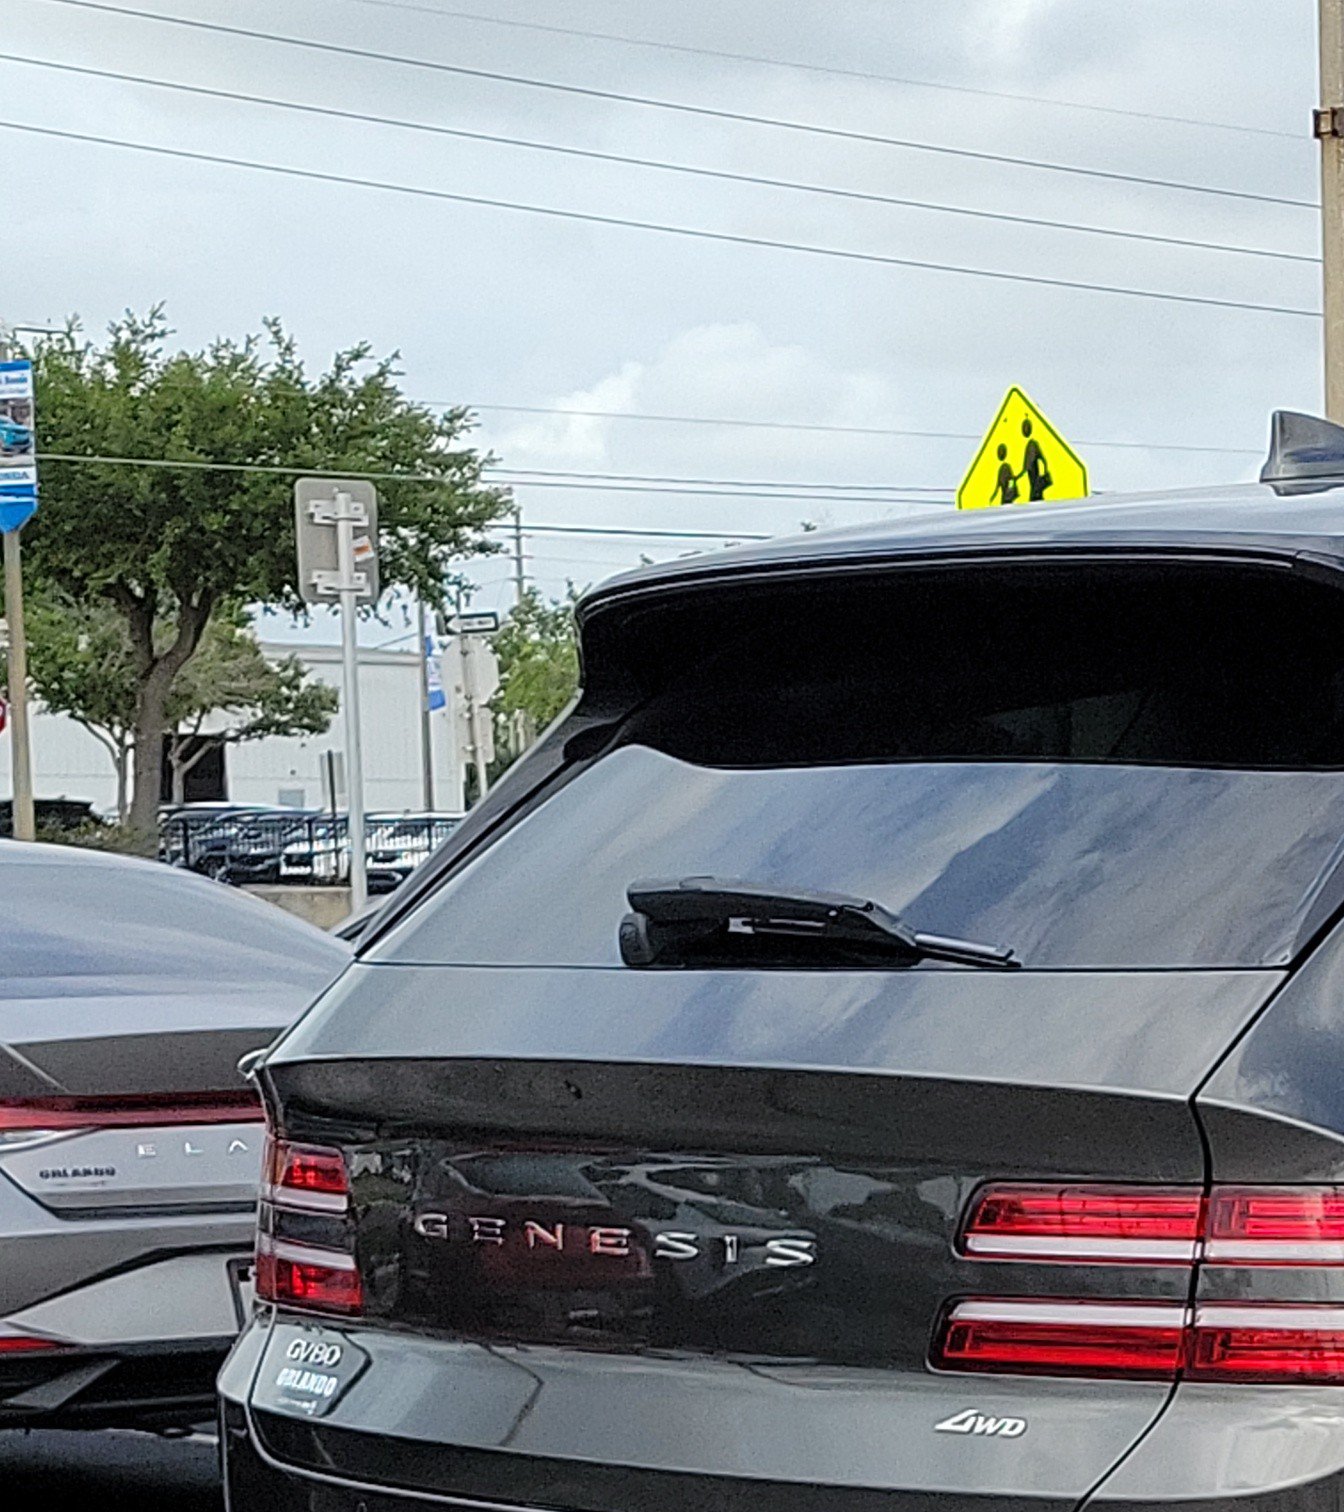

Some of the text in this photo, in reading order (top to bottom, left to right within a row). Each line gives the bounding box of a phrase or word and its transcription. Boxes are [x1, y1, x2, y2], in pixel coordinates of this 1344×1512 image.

[414, 1213, 818, 1267] GENESIS
[286, 1338, 342, 1367] GV80
[276, 1367, 338, 1398] ORLANDO
[934, 1408, 1027, 1437] 4WD
